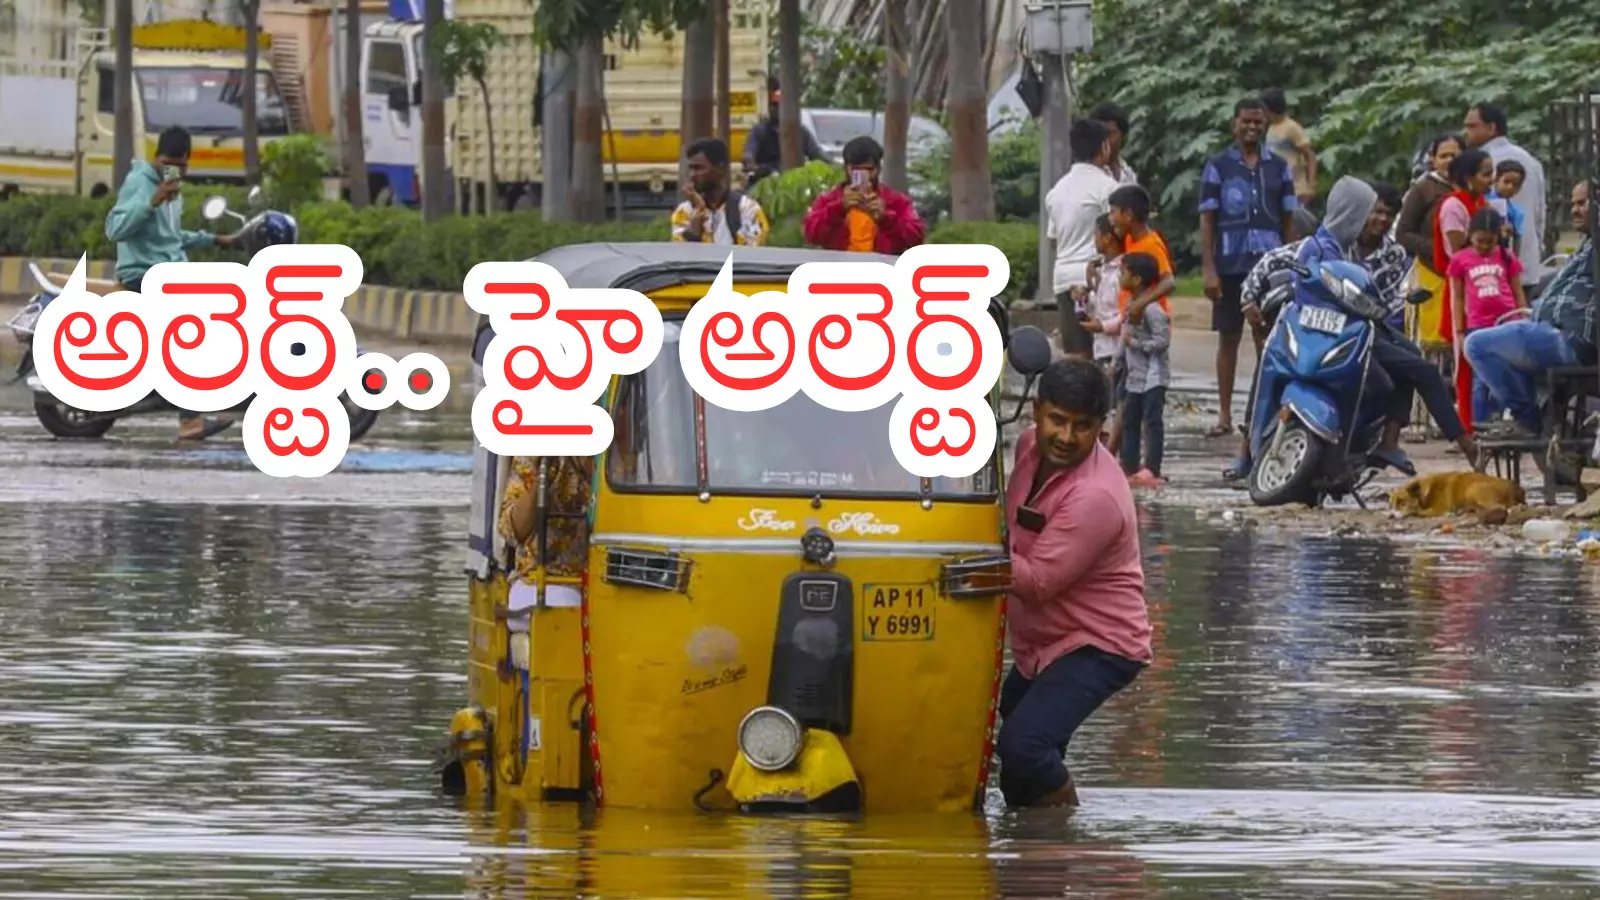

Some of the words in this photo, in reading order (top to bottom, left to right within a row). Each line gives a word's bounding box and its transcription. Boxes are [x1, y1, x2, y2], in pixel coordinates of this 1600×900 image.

[873, 588, 900, 608] AP
[905, 588, 924, 608] 11
[868, 615, 881, 635] Y
[887, 614, 930, 635] 6991
